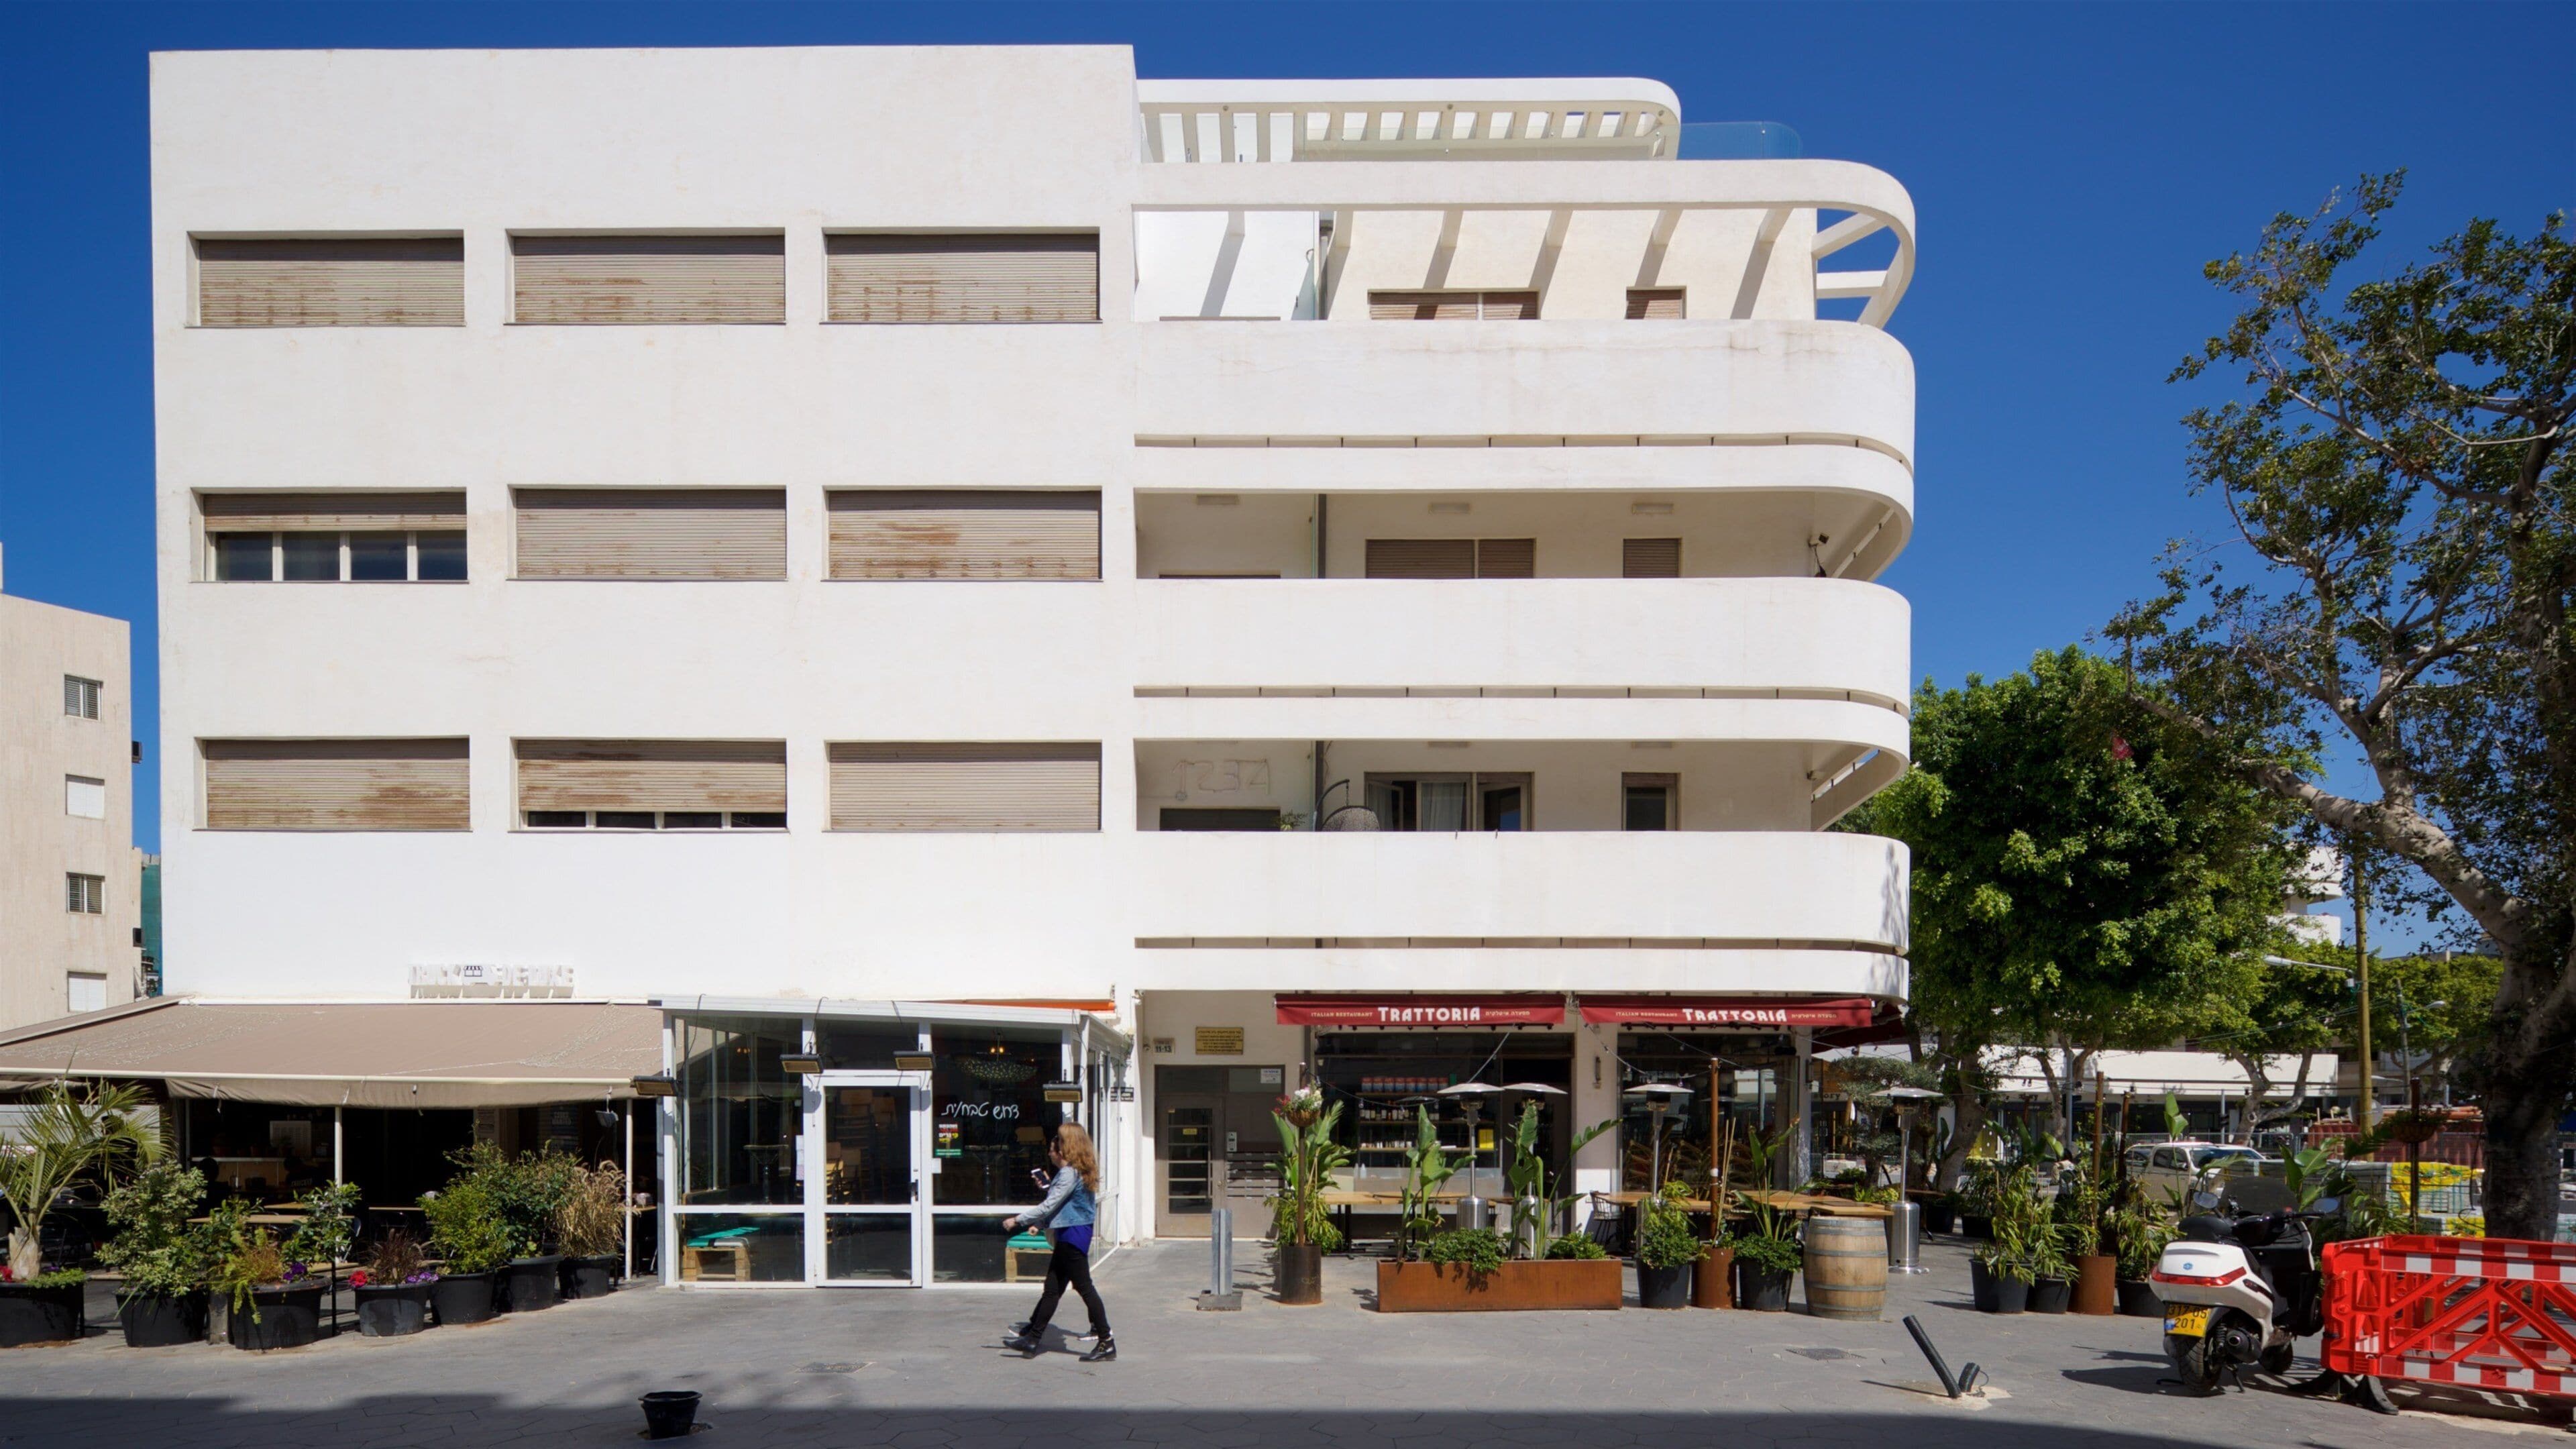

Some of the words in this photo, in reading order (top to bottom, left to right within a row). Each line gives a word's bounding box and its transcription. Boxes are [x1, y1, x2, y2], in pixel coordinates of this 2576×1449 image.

[1377, 1007, 1481, 1022] TRATTORIA
[1682, 1008, 1787, 1022] TRATTORIA
[2175, 1318, 2196, 1330] 201
